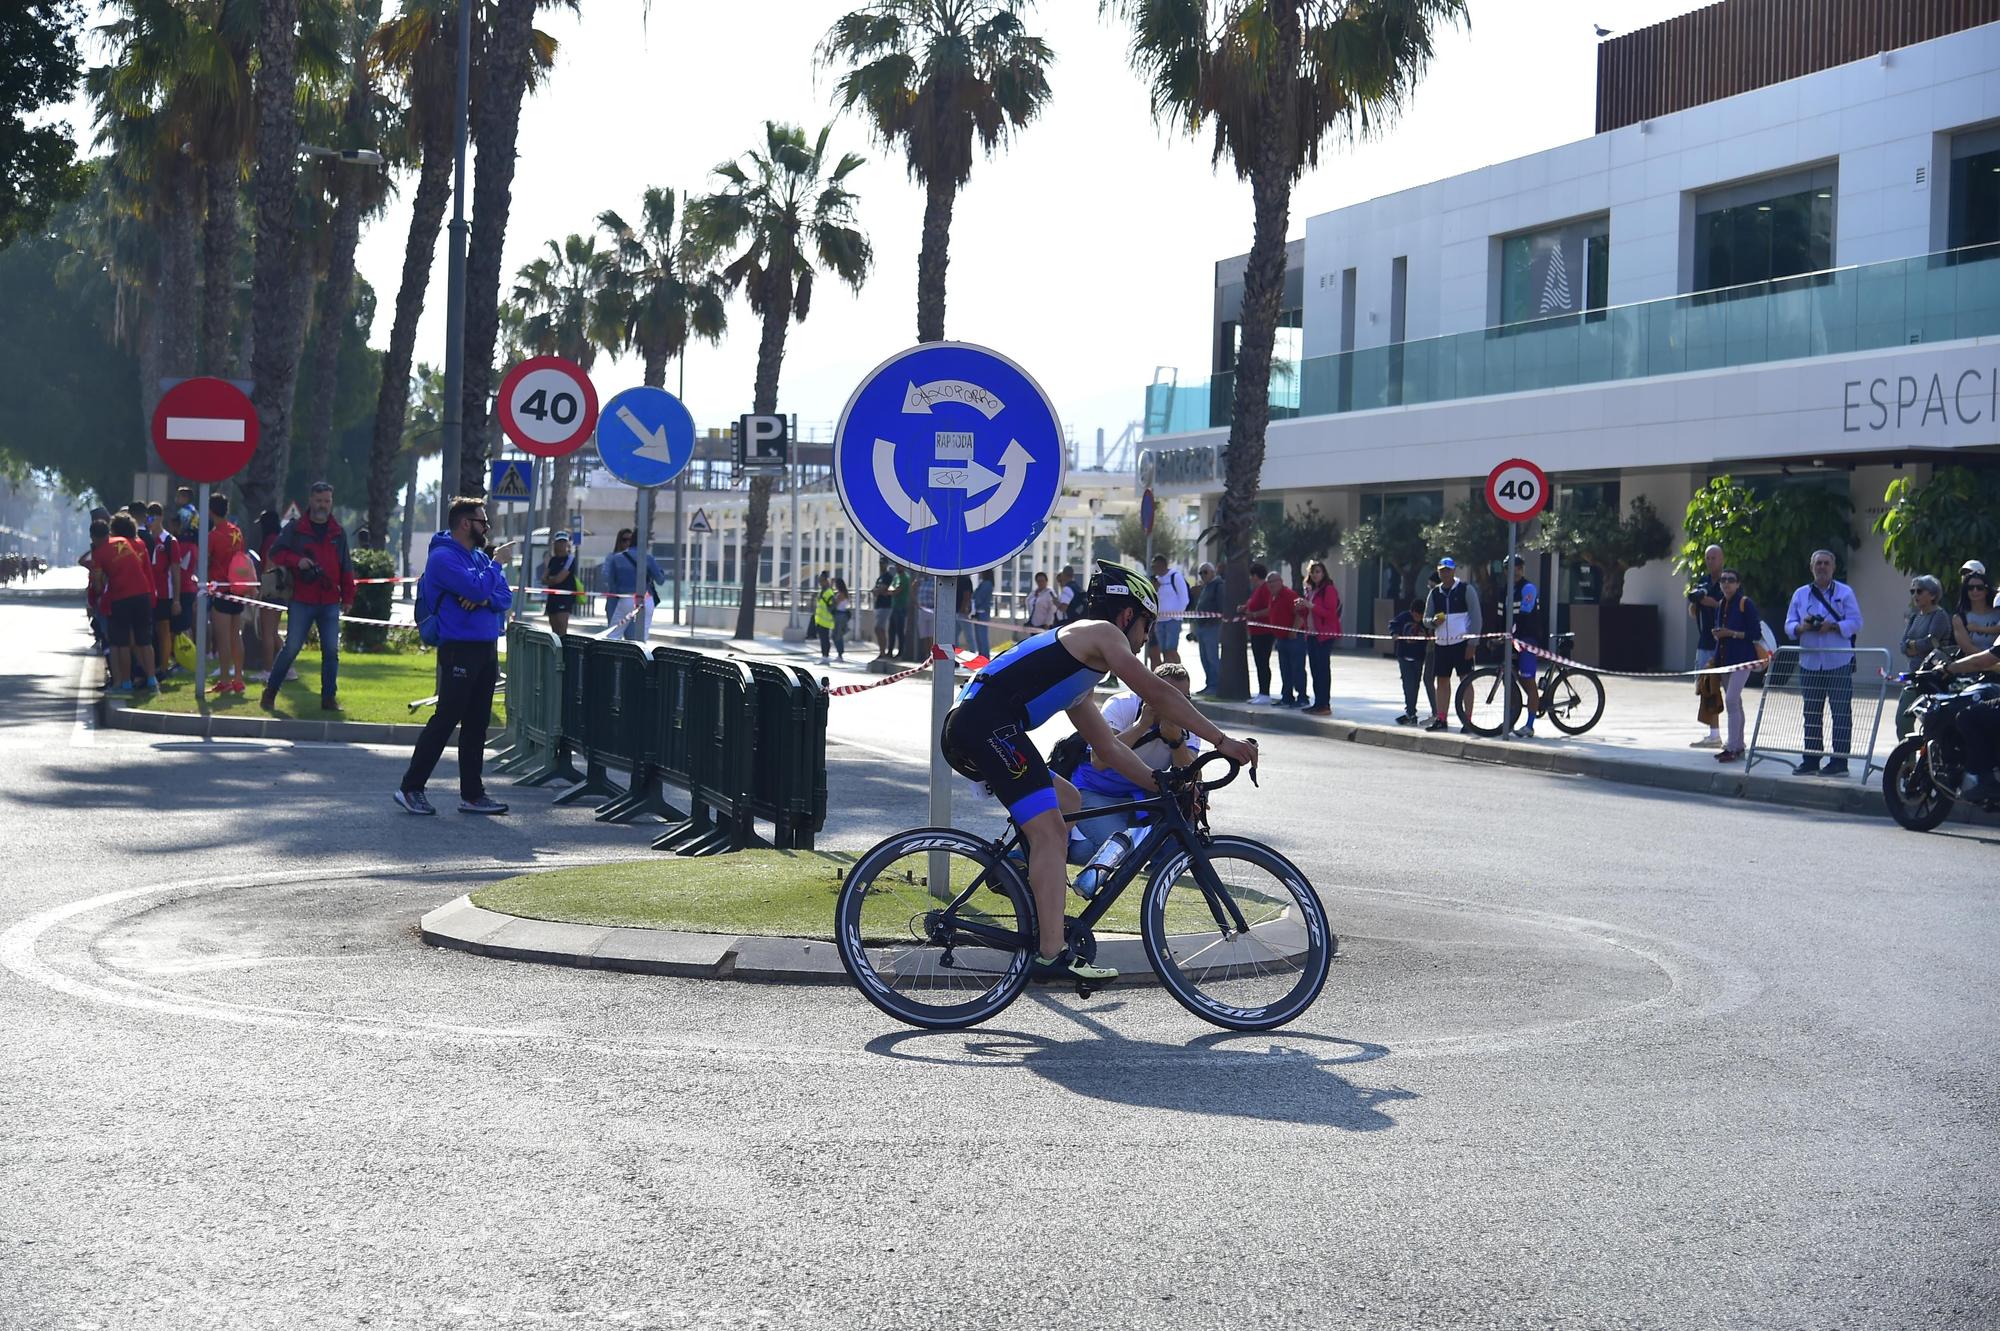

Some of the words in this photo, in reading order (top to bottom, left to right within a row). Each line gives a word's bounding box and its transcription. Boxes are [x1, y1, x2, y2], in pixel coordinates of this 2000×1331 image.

[520, 388, 577, 425] 40
[1844, 368, 1997, 432] ESPACI
[746, 416, 783, 457] P
[1499, 480, 1535, 501] 40
[899, 838, 978, 855] ZIPP
[1284, 877, 1322, 948] ZIPP
[848, 923, 891, 994] ZIPP
[1194, 993, 1268, 1018] ZIPP
